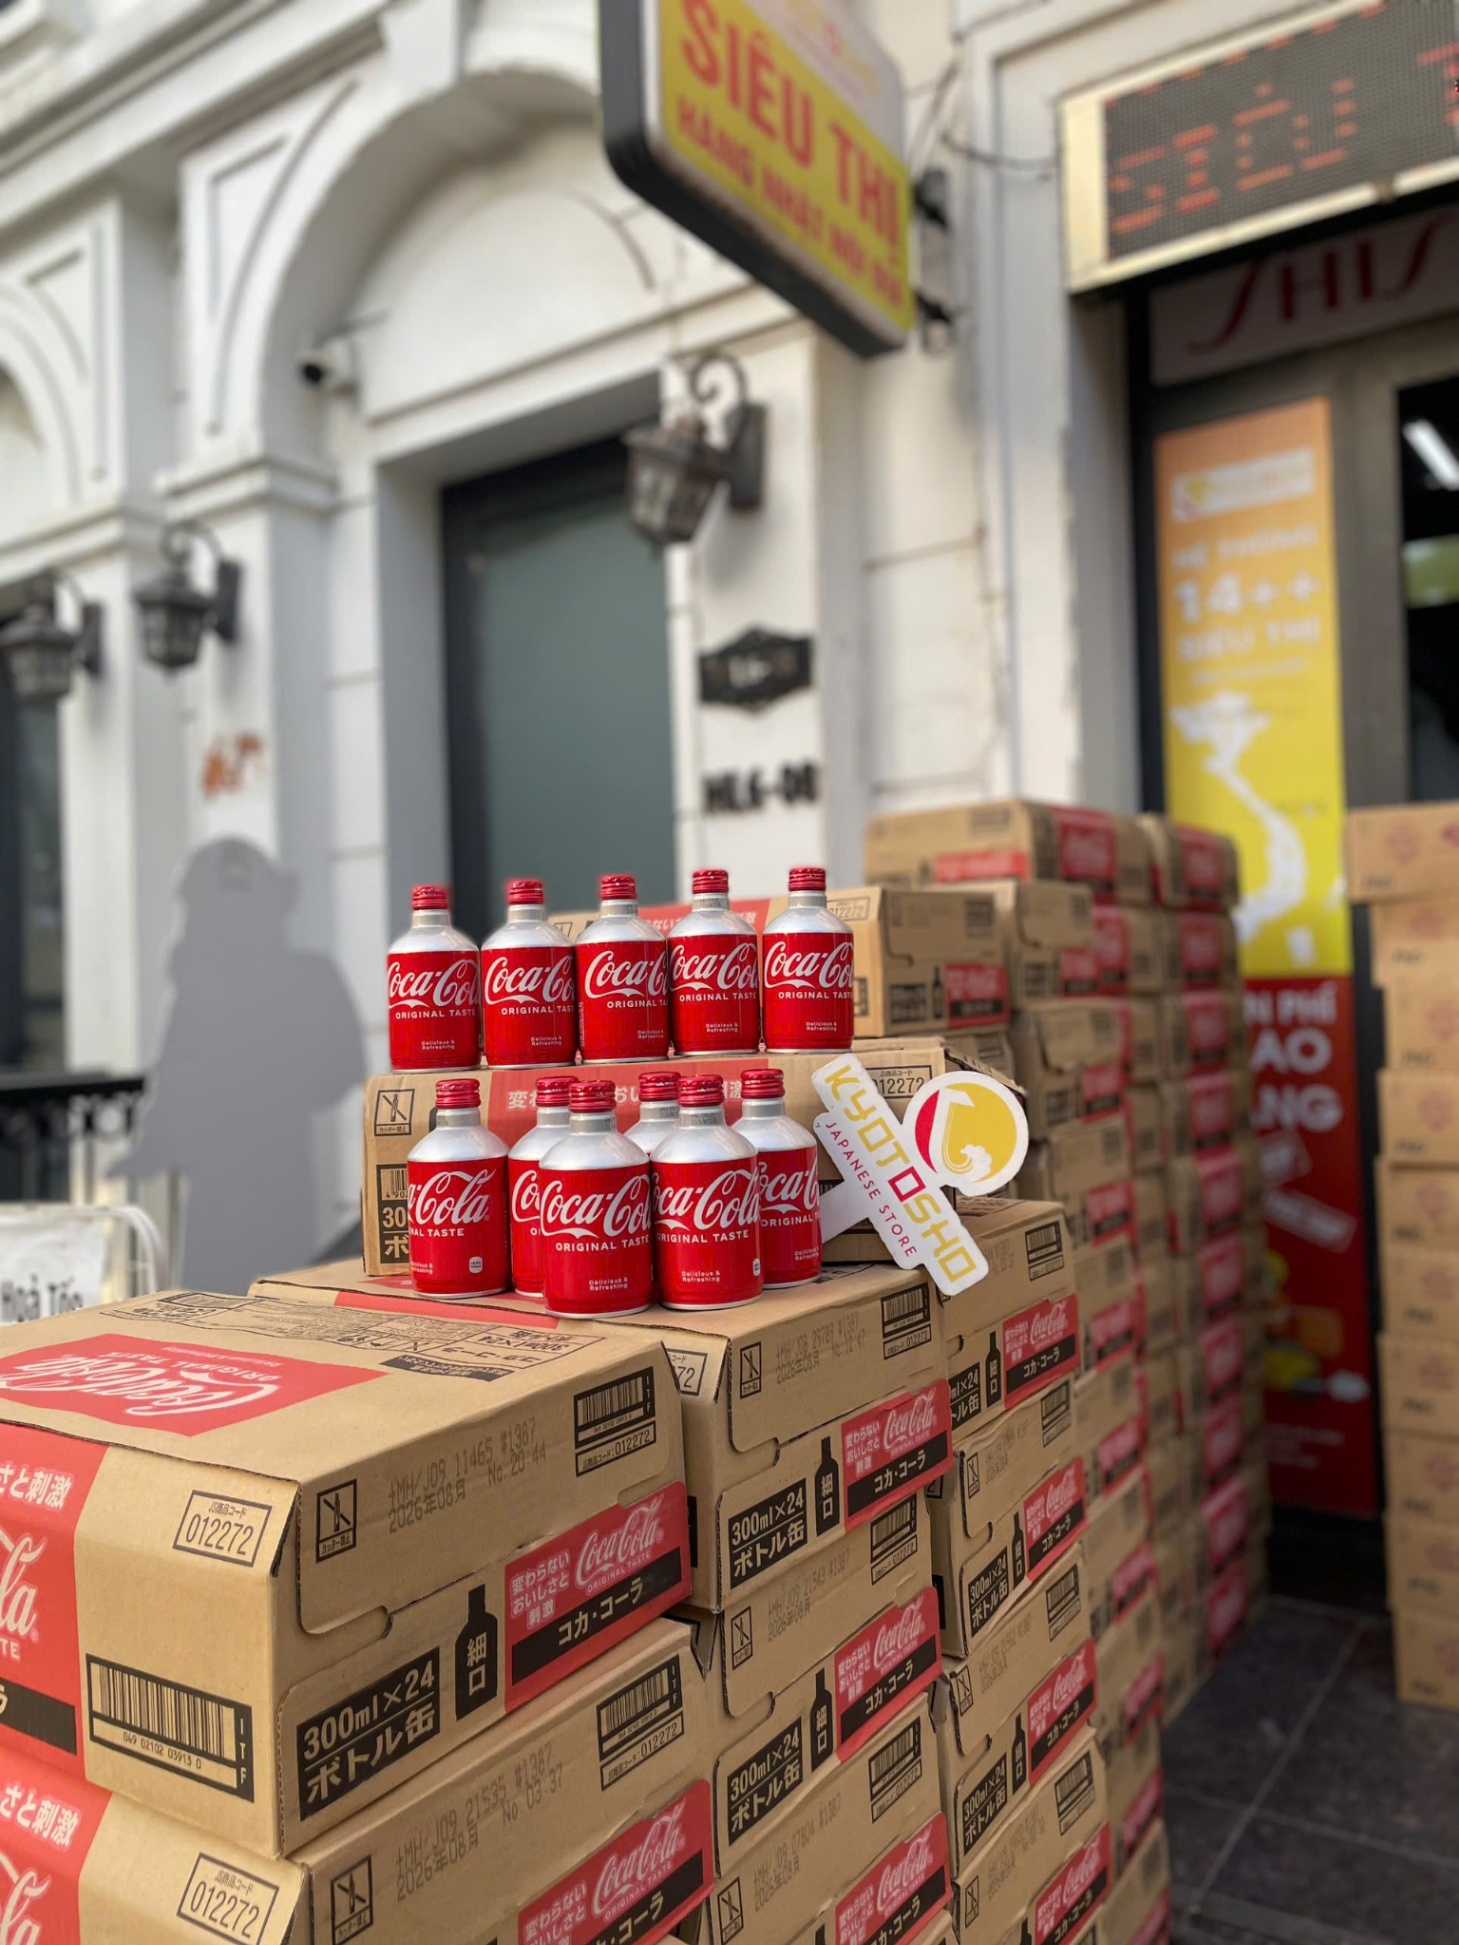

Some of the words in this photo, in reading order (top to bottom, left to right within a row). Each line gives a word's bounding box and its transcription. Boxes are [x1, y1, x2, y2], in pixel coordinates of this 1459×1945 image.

[395, 1009, 445, 1020] ORIGINAL
[449, 1008, 476, 1017] TASTE
[501, 1006, 554, 1017] ORIGINAL
[557, 1004, 574, 1014] TAST
[607, 1000, 657, 1009] ORIGINAL
[679, 991, 729, 1003] ORIGINAL
[732, 991, 757, 1000] TASTE
[778, 991, 829, 999] ORIGINAL
[1250, 1027, 1334, 1076] AO
[824, 1065, 977, 1283] KYOTOSHO
[826, 1122, 881, 1200] JAPANESE
[879, 1204, 917, 1257] STORE
[542, 1174, 651, 1238] Coca-Col
[761, 1214, 813, 1227] ORIGINAL
[427, 1228, 464, 1237] TASTE
[556, 1241, 617, 1252] ORIGINAL
[622, 1234, 649, 1248] TASTE
[657, 1232, 707, 1244] ORIGINAL
[713, 1230, 749, 1242] TASTE
[589, 1283, 628, 1291] Refreshing
[0, 1355, 279, 1416] Coca-Cola
[172, 1360, 283, 1382] ORIGINAL
[951, 1368, 979, 1400] ml×24
[1023, 1347, 1060, 1379] コカ・コーラ
[845, 1420, 880, 1449] 変わらない
[884, 1387, 937, 1449] Coca-Cola
[951, 1395, 980, 1427] トル缶
[454, 1436, 493, 1478] 11465
[501, 1415, 536, 1454] #1387
[615, 1429, 650, 1456] 012272
[846, 1436, 880, 1464] おいしさと
[821, 1472, 834, 1520] 細口
[874, 1450, 926, 1494] コカ・コーラ
[388, 1478, 466, 1533] 2026年08月
[731, 1487, 804, 1547] 300ml×24
[186, 1514, 254, 1555] 012272
[576, 1493, 664, 1586] Coca-Cola
[734, 1519, 805, 1578] ボトル缶
[512, 1552, 569, 1595] 変わらない
[513, 1572, 569, 1615] おいしさと
[587, 1567, 625, 1593] ORIGINAL
[628, 1552, 651, 1569] TASTE
[529, 1599, 554, 1626] 刺激
[559, 1577, 643, 1646] コカ・コーラ
[972, 1580, 1008, 1628] ボトル缶
[874, 1593, 924, 1669] Coca-Cola
[467, 1632, 487, 1696] 細口
[866, 1660, 913, 1715] コカ・コーラ
[303, 1659, 435, 1760] 300ml×24
[140, 1738, 163, 1757] 02102
[239, 1716, 247, 1785] ITF
[307, 1702, 435, 1804] ボトル缶
[641, 1722, 678, 1758] 012272
[730, 1726, 799, 1802] 300ml×24
[731, 1759, 800, 1833] ボトル缶
[965, 1784, 1006, 1847] ボトル缶
[397, 1824, 479, 1903] 2026年08月
[593, 1797, 686, 1915] Coca-Cola
[878, 1822, 932, 1912] Coca-Cola
[190, 1880, 260, 1939] 012272
[525, 1883, 587, 1940] 変わらない
[605, 1885, 646, 1920] ORIGINAL
[648, 1861, 673, 1887] TASTE
